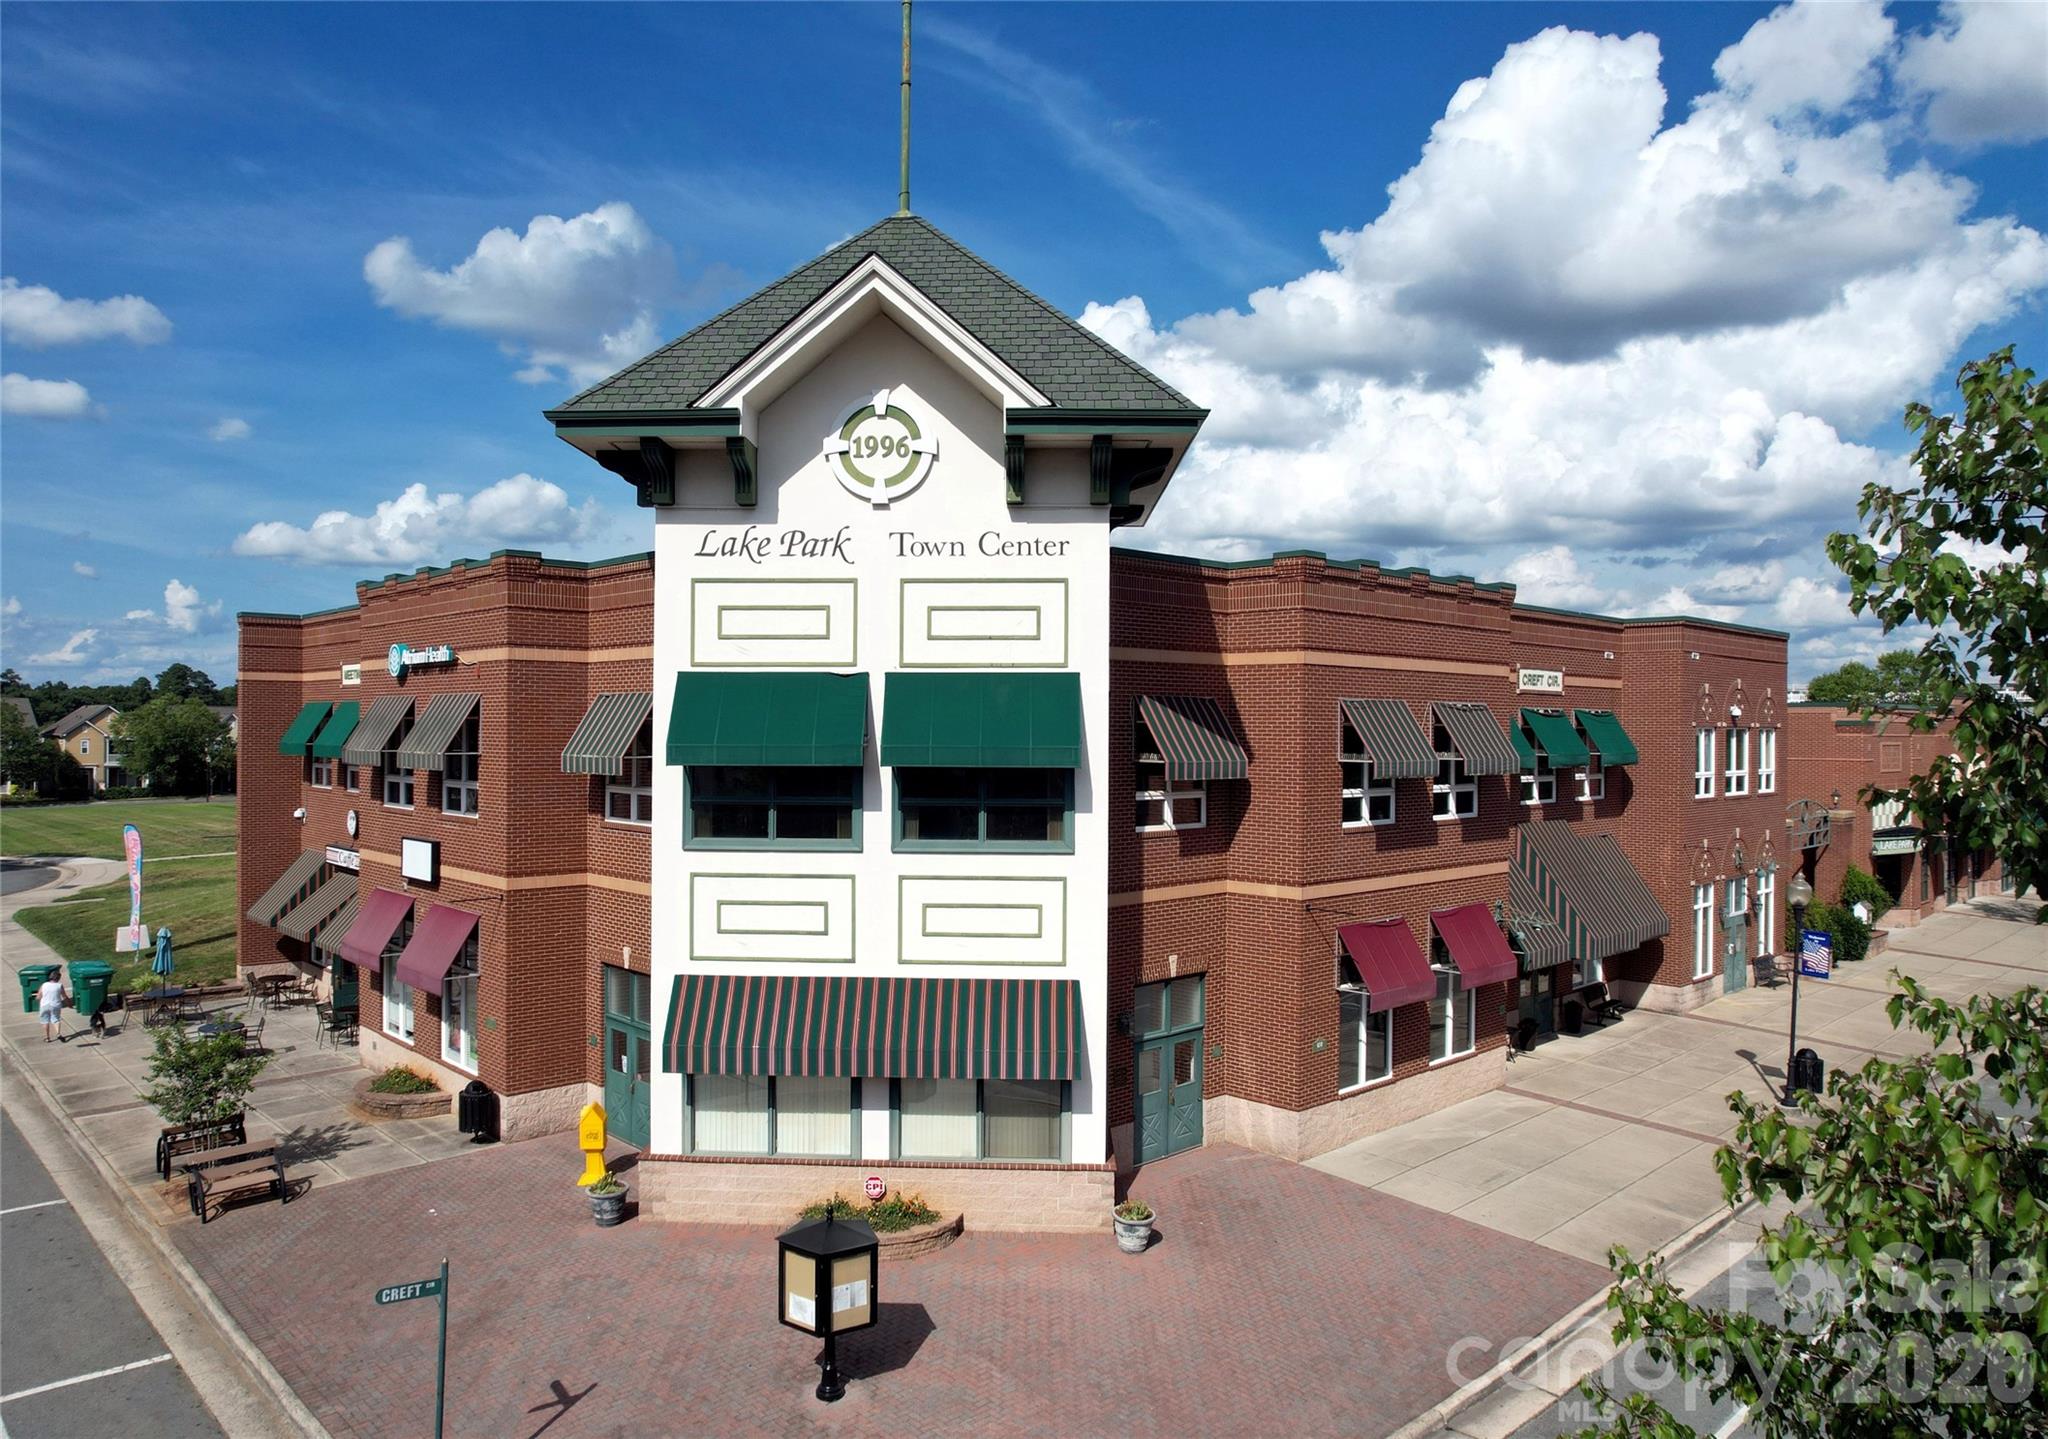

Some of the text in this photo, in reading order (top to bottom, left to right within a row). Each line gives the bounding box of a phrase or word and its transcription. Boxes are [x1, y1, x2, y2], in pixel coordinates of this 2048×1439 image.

[852, 435, 911, 459] 1996
[694, 525, 1070, 564] Lake Park Town Center
[1522, 673, 1544, 686] CREFT
[382, 1284, 422, 1303] CREFT
